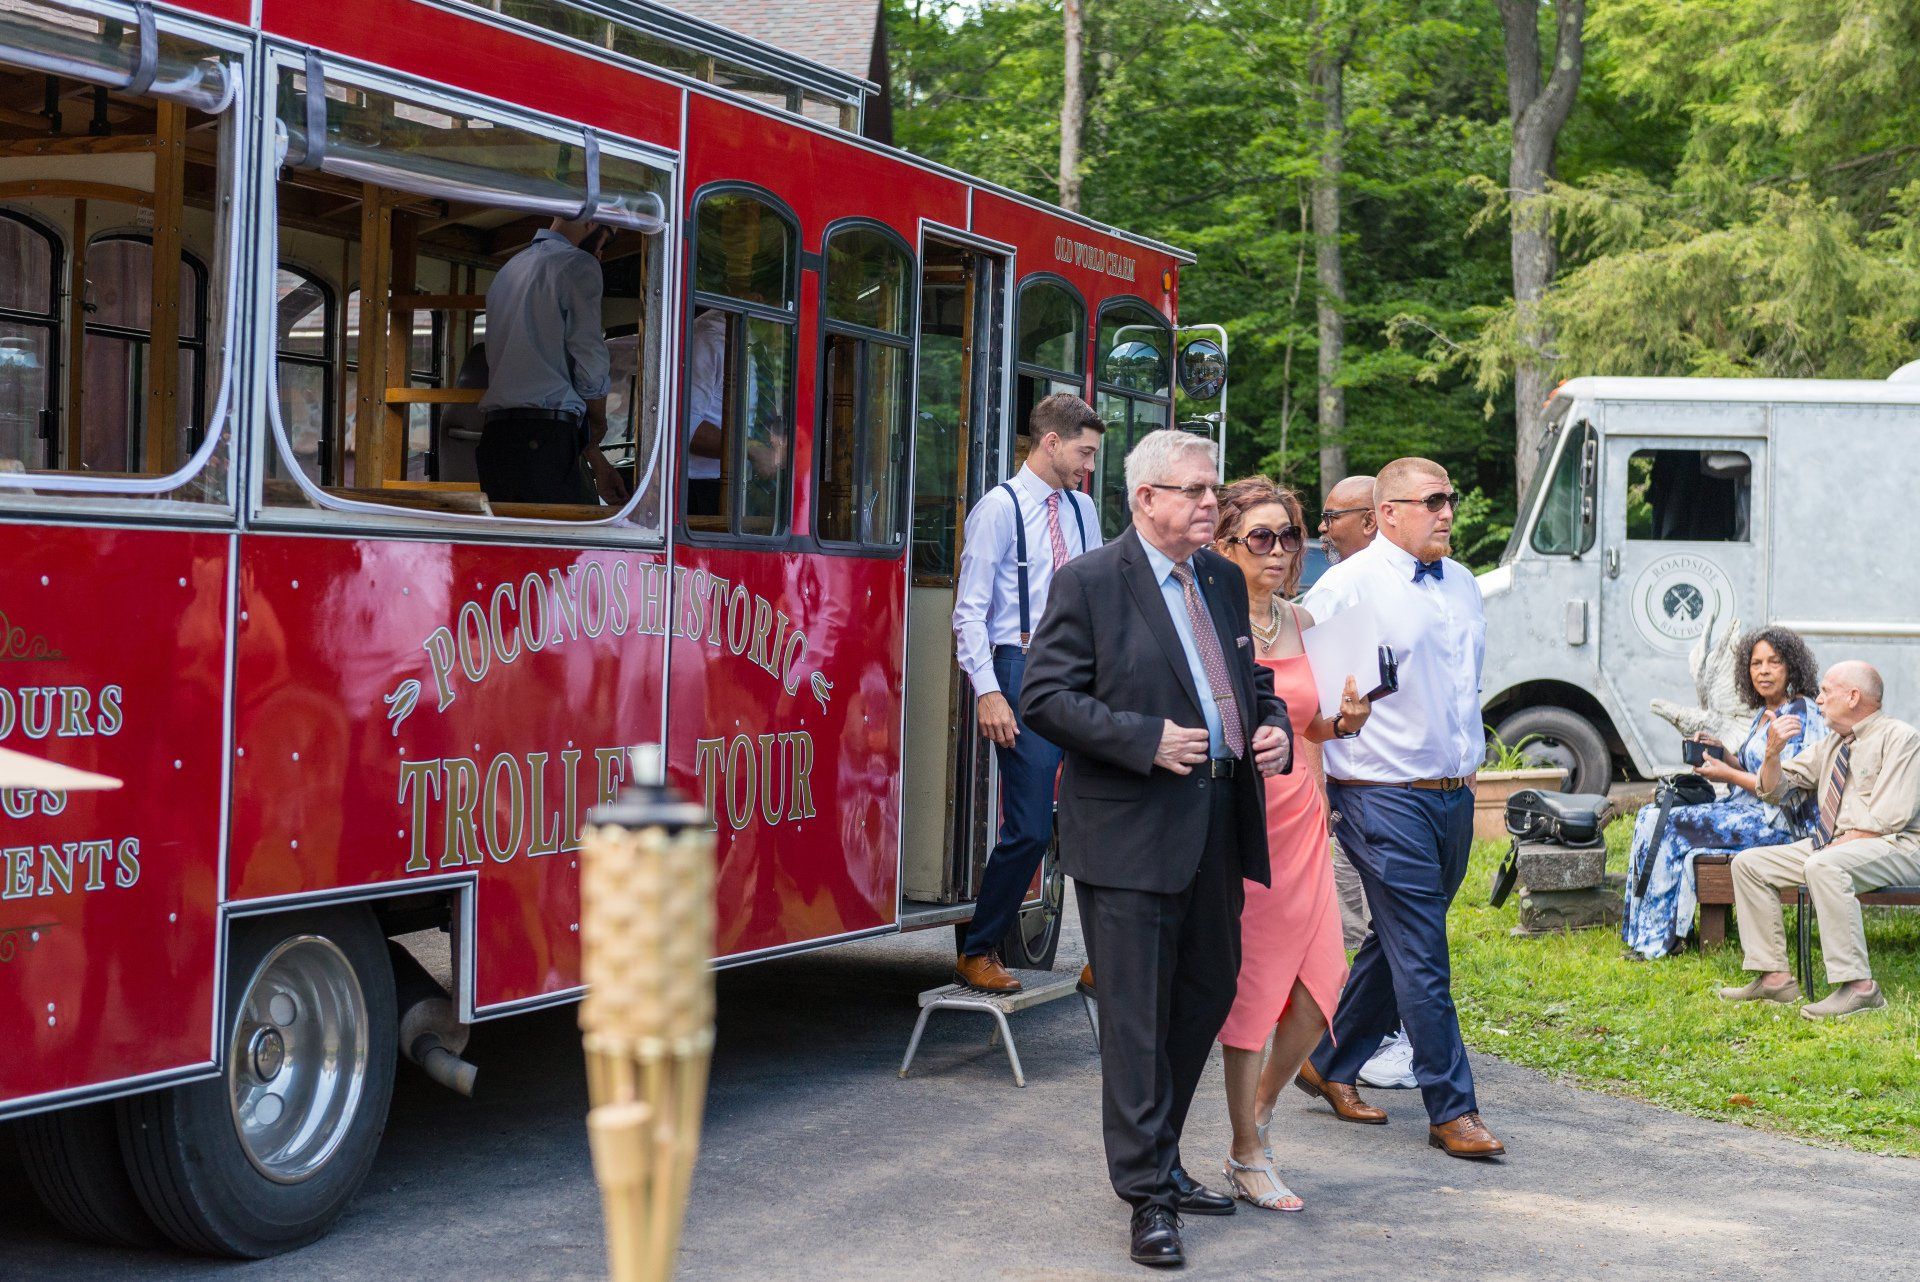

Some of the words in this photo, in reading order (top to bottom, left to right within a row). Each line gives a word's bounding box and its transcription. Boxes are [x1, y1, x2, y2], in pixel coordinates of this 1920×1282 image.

[1054, 235, 1074, 263] OLD
[1073, 241, 1106, 273] WORLD
[1106, 251, 1136, 282] CHARM
[1652, 556, 1719, 581] ROADSIDE
[423, 560, 630, 713] POCONOS
[637, 562, 809, 697] HISTORIC
[398, 744, 662, 873] TROLLE
[695, 730, 817, 832] TOUR
